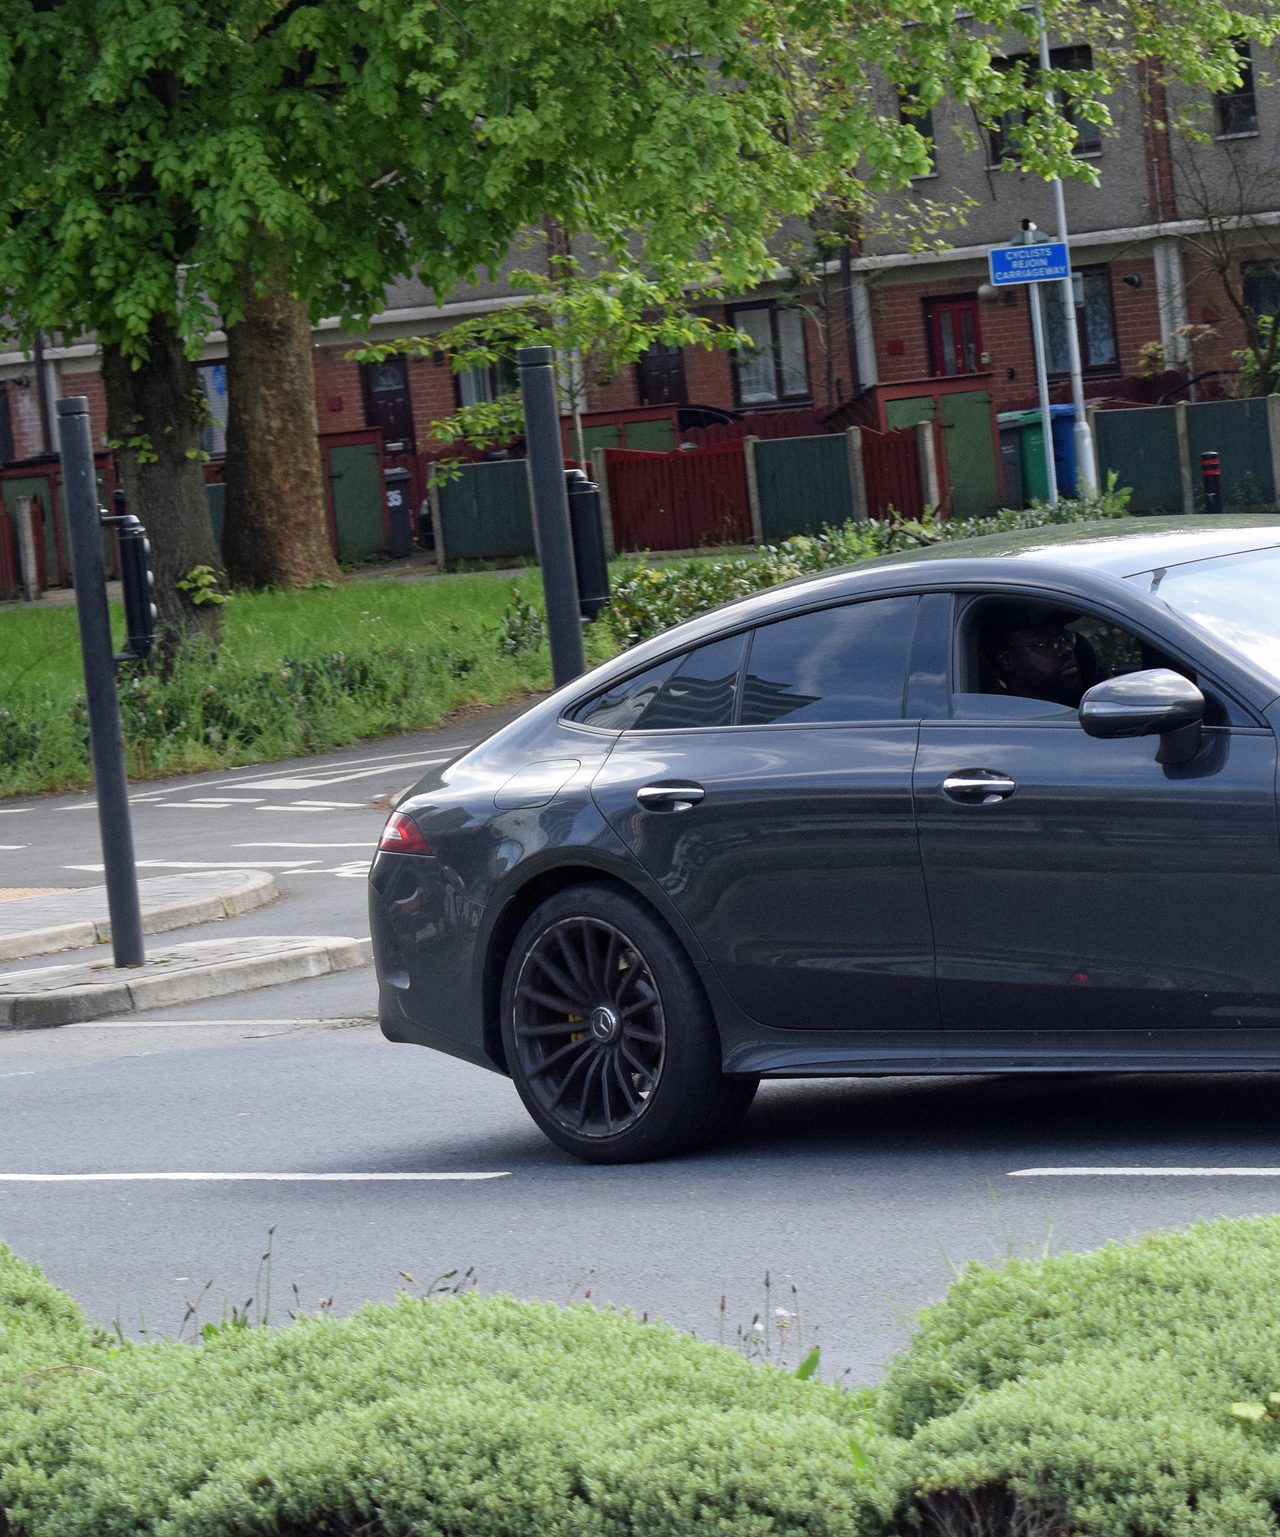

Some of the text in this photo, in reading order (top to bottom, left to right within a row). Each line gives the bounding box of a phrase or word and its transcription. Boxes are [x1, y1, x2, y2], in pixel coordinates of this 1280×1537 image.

[1005, 248, 1052, 260] CYCLISTS
[1011, 258, 1049, 269] REJOIN
[995, 266, 1066, 280] CARRIAGEWAY
